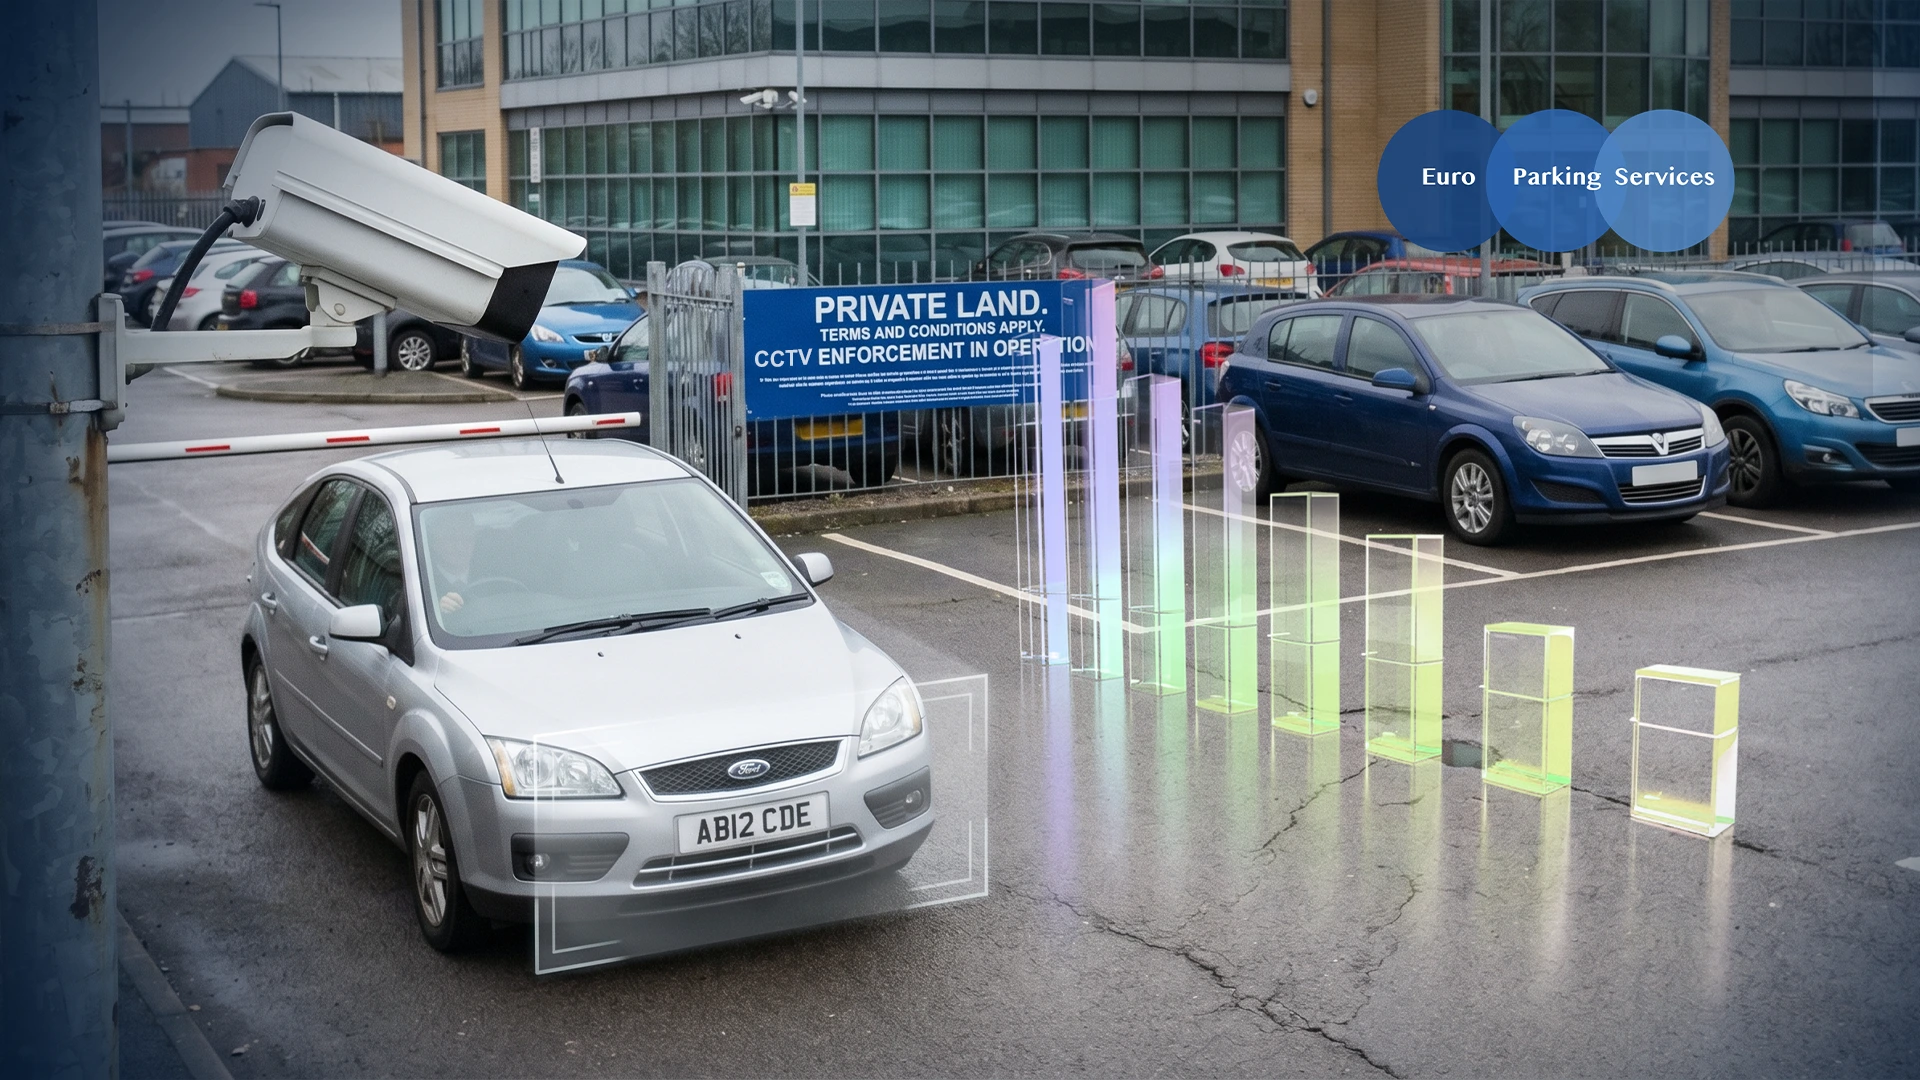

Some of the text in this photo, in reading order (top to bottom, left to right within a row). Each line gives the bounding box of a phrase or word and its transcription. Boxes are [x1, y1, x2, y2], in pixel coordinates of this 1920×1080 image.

[815, 289, 1048, 323] PRIVATE LAND.
[820, 319, 1046, 342] TERMS AND CONDITIONS APPLY.
[754, 335, 1097, 368] CCTV ENFORCEMENT IN OPERTION
[737, 762, 761, 775] Ford
[697, 801, 812, 845] AB12 CDE
